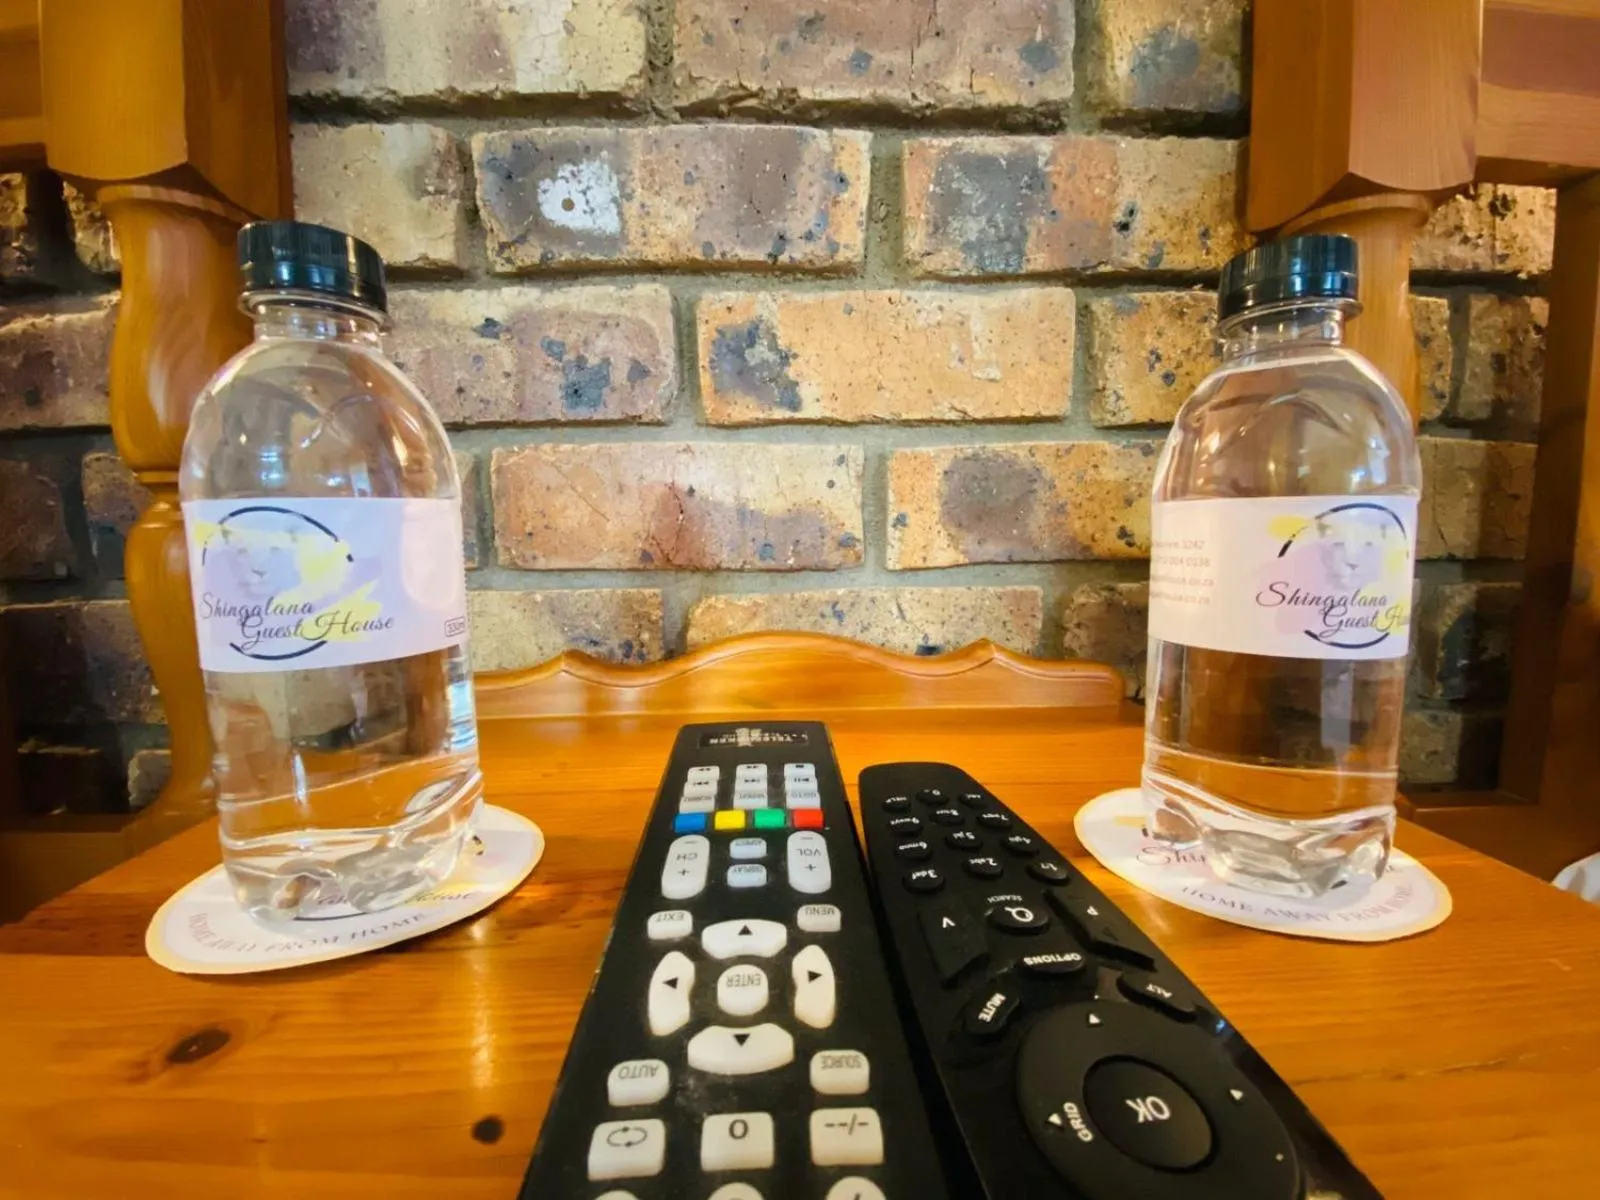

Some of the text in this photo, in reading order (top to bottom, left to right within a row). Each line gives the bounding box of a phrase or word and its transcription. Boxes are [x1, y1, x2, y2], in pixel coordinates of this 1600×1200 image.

[1256, 581, 1387, 609] Shingalana
[1319, 605, 1377, 637] Guest
[241, 611, 395, 650] Guest House
[676, 852, 698, 861] CH
[797, 847, 822, 857] VOL
[987, 894, 1023, 904] SEARCH
[1181, 886, 1254, 912] HOME
[1264, 907, 1332, 922] AWAY
[655, 912, 685, 923] EXIT
[805, 906, 836, 916] MENU
[264, 935, 340, 952] FROM
[350, 914, 425, 941] HOME
[1023, 953, 1083, 966] OPTIONS
[726, 973, 762, 988] ENTER
[978, 992, 1007, 1023] MUTE
[820, 1055, 862, 1069] SOURCE
[617, 1064, 660, 1080] AUTO
[1125, 1095, 1172, 1125] OK
[1062, 1101, 1095, 1143] GRID
